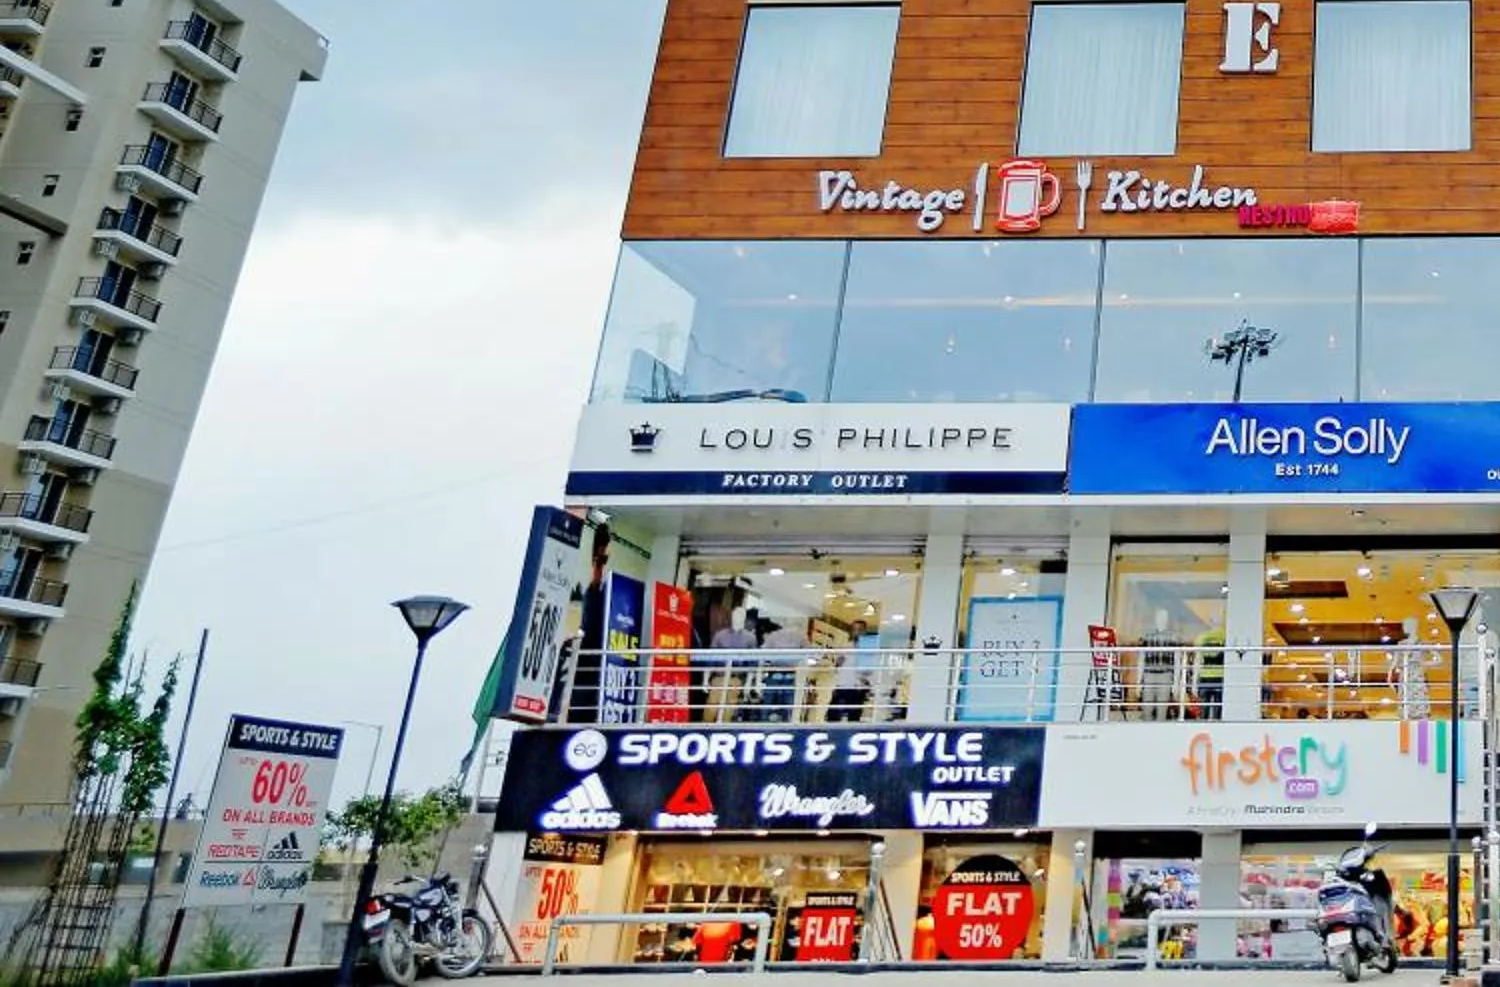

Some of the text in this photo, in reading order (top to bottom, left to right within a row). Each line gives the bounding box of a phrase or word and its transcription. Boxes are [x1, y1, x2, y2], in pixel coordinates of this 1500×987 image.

[817, 164, 1258, 232] Vintage Kitchen
[836, 428, 1013, 450] PHILIPPE
[1205, 417, 1411, 464] Allen Solly
[721, 473, 909, 489] FACTORY OUTLET
[1275, 463, 1339, 477] Est 1744
[239, 723, 338, 751] SPORTS & STYLE
[618, 732, 794, 765] SPORTS
[804, 732, 835, 765] &
[848, 732, 983, 764] STYLE
[251, 759, 310, 808] 60%
[932, 766, 1015, 784] OUTLET
[222, 808, 316, 826] ON ALL BRANDS
[760, 783, 875, 827] Wrangler
[911, 791, 993, 827] VANS
[1244, 804, 1305, 814] Mahindra
[541, 812, 622, 829] adidas
[951, 871, 985, 884] SPORTS
[993, 871, 1020, 883] STYLE
[537, 868, 579, 920] 50%
[946, 892, 1023, 917] FLAT
[803, 916, 851, 947] FLAT
[959, 922, 1003, 949] 50%
